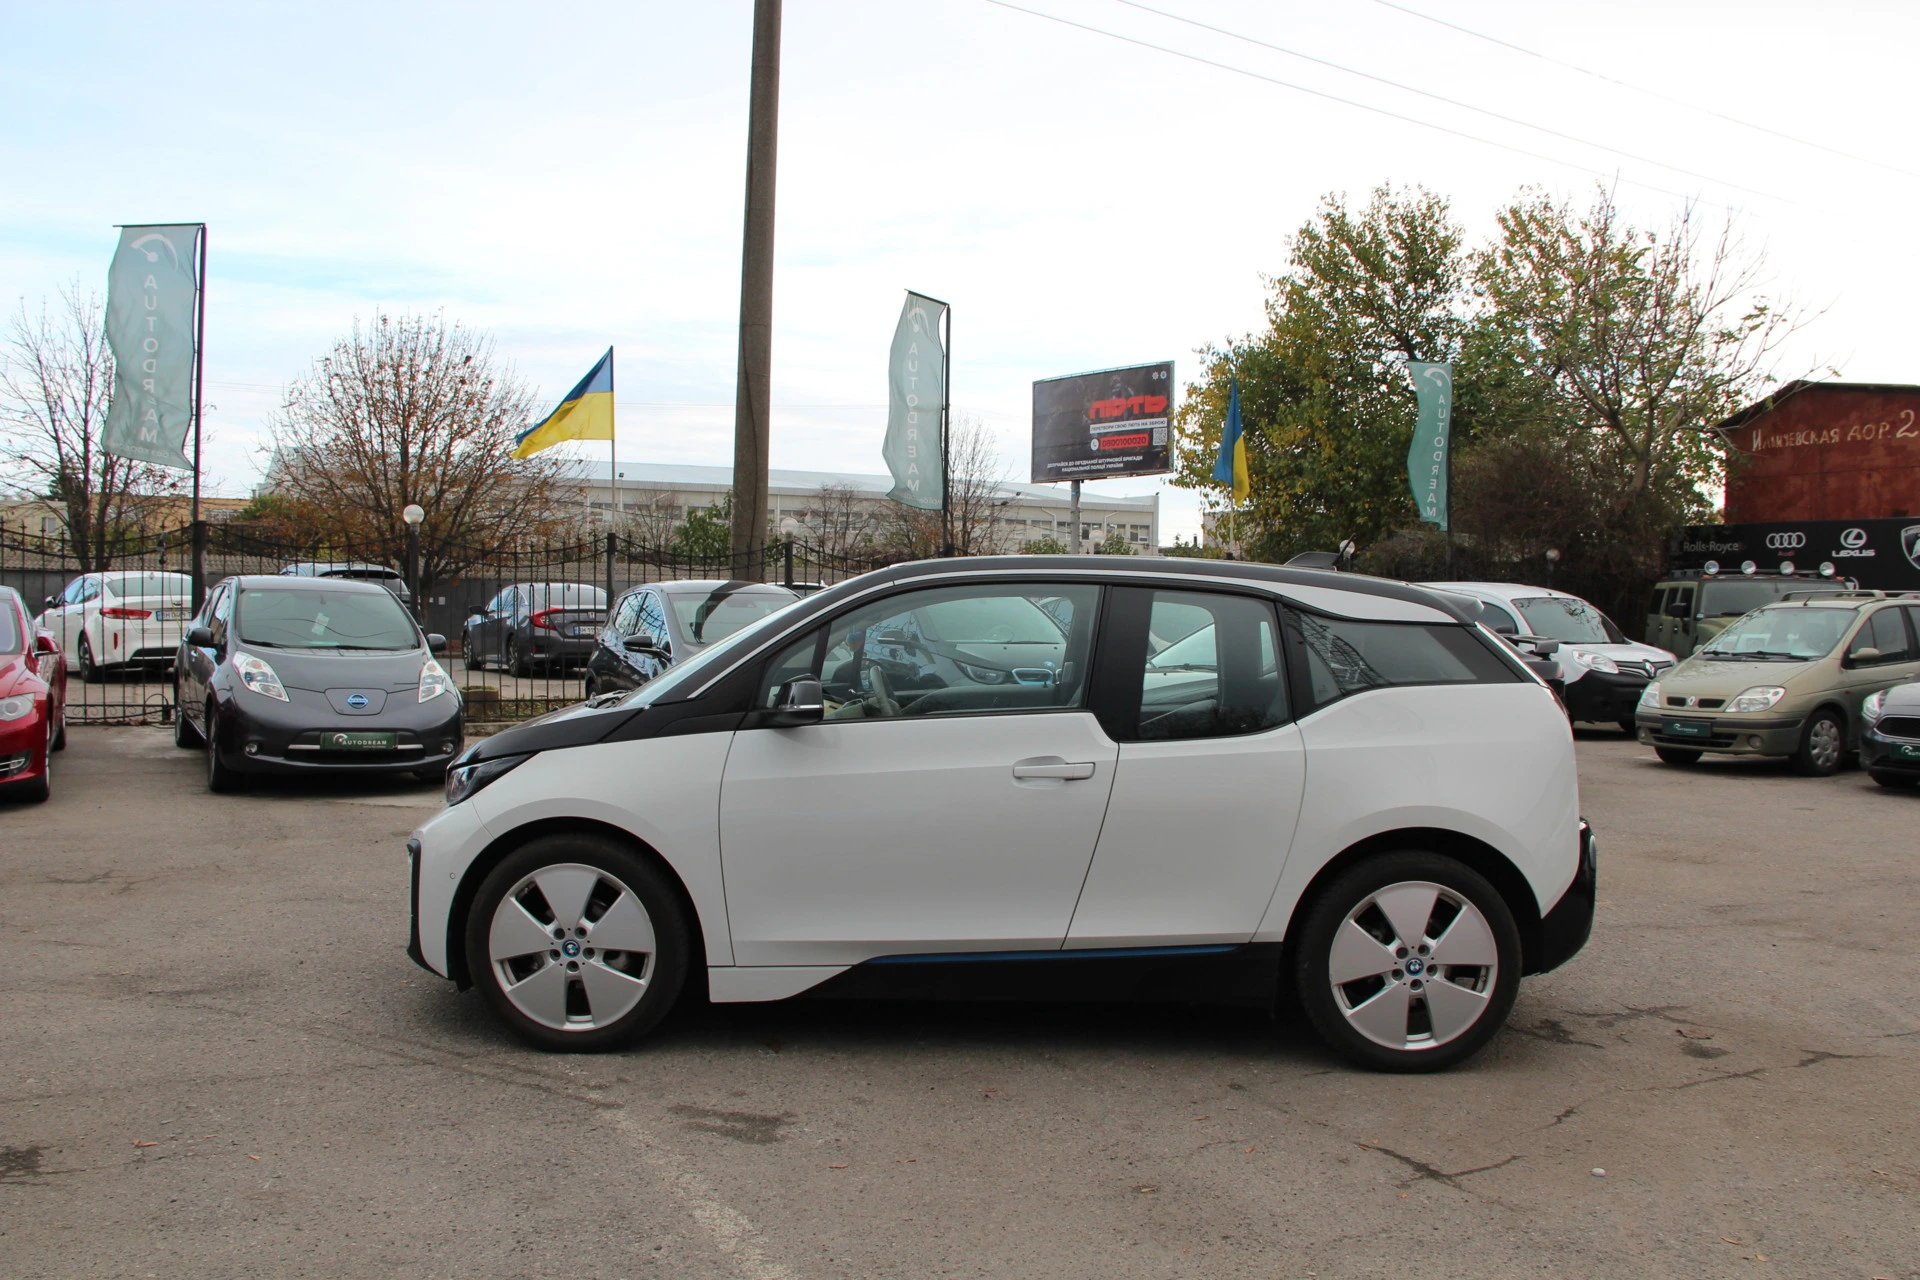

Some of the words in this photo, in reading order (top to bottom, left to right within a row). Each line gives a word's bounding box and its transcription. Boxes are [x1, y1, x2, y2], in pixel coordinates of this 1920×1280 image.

[1896, 409, 1920, 439] 2
[1683, 540, 1739, 554] Rolls-Royce
[1832, 549, 1876, 557] LEXUS
